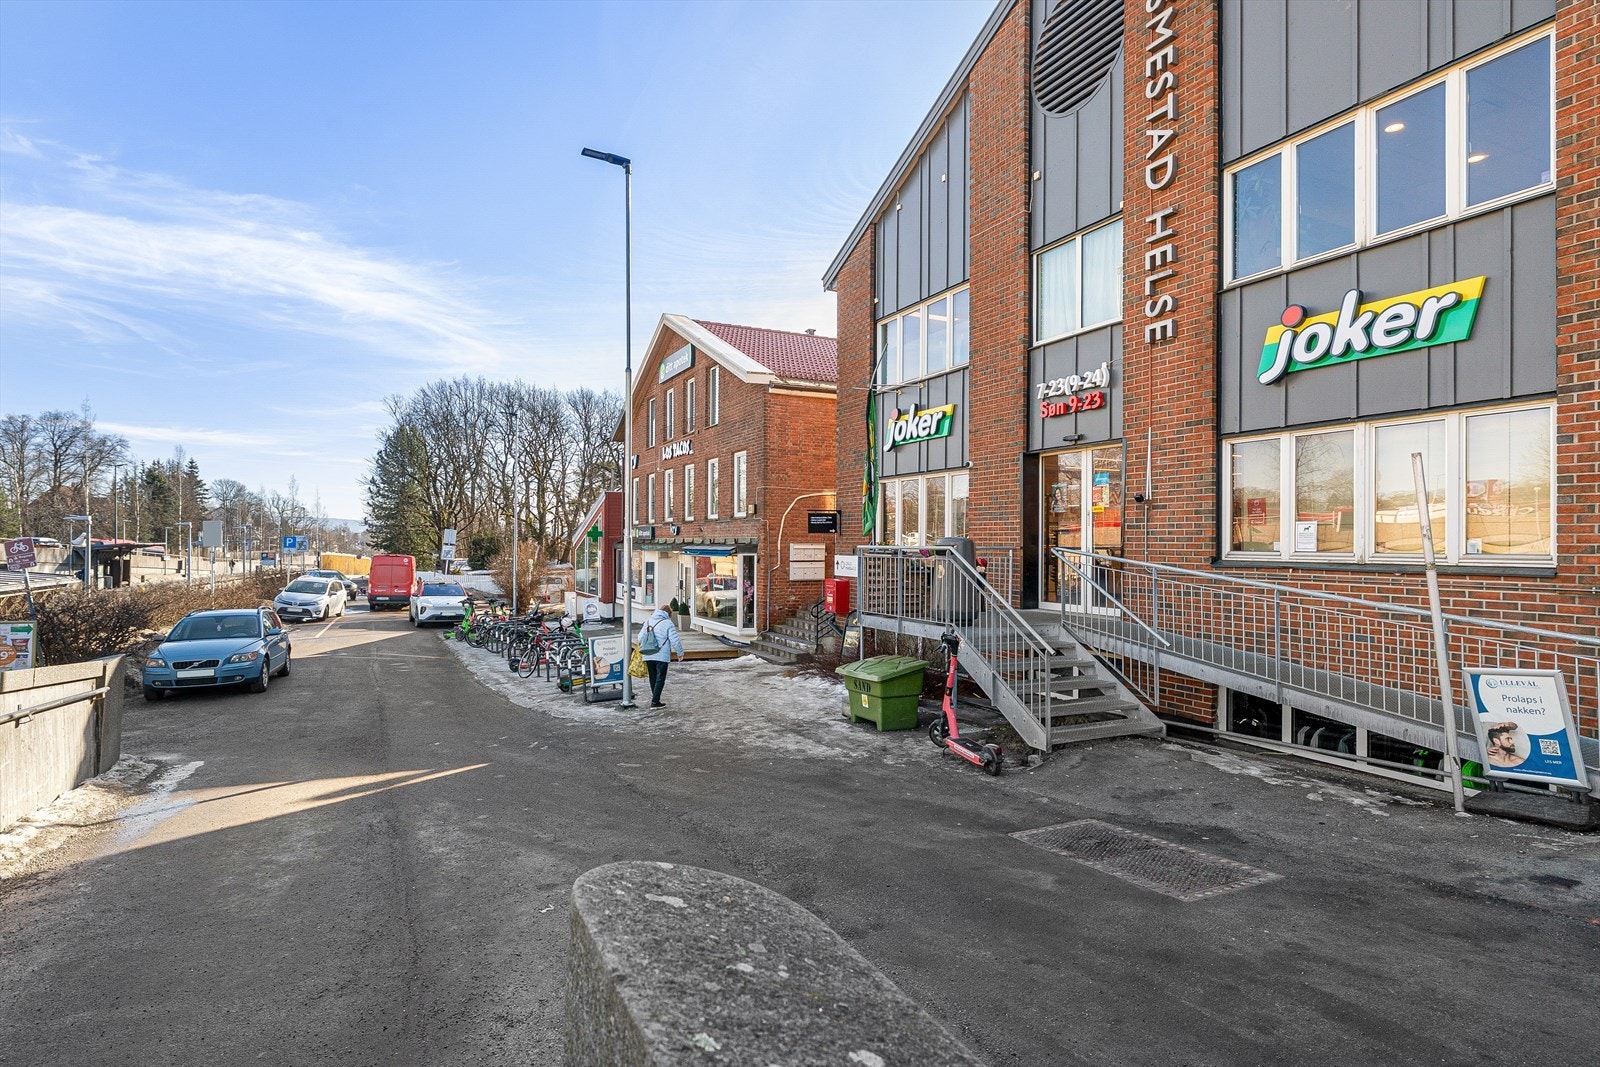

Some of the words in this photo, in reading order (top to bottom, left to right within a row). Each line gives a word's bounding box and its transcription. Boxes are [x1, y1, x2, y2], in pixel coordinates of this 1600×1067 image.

[1144, 207, 1178, 344] HELSE
[1257, 288, 1460, 385] joker
[1040, 401, 1067, 418] Søn
[1068, 390, 1105, 413] 9-23
[883, 403, 946, 452] joker
[662, 446, 673, 460] LOS
[286, 537, 294, 547] P
[853, 680, 872, 693] SAND
[1501, 694, 1538, 705] Prolaps
[1505, 706, 1546, 716] nakken?
